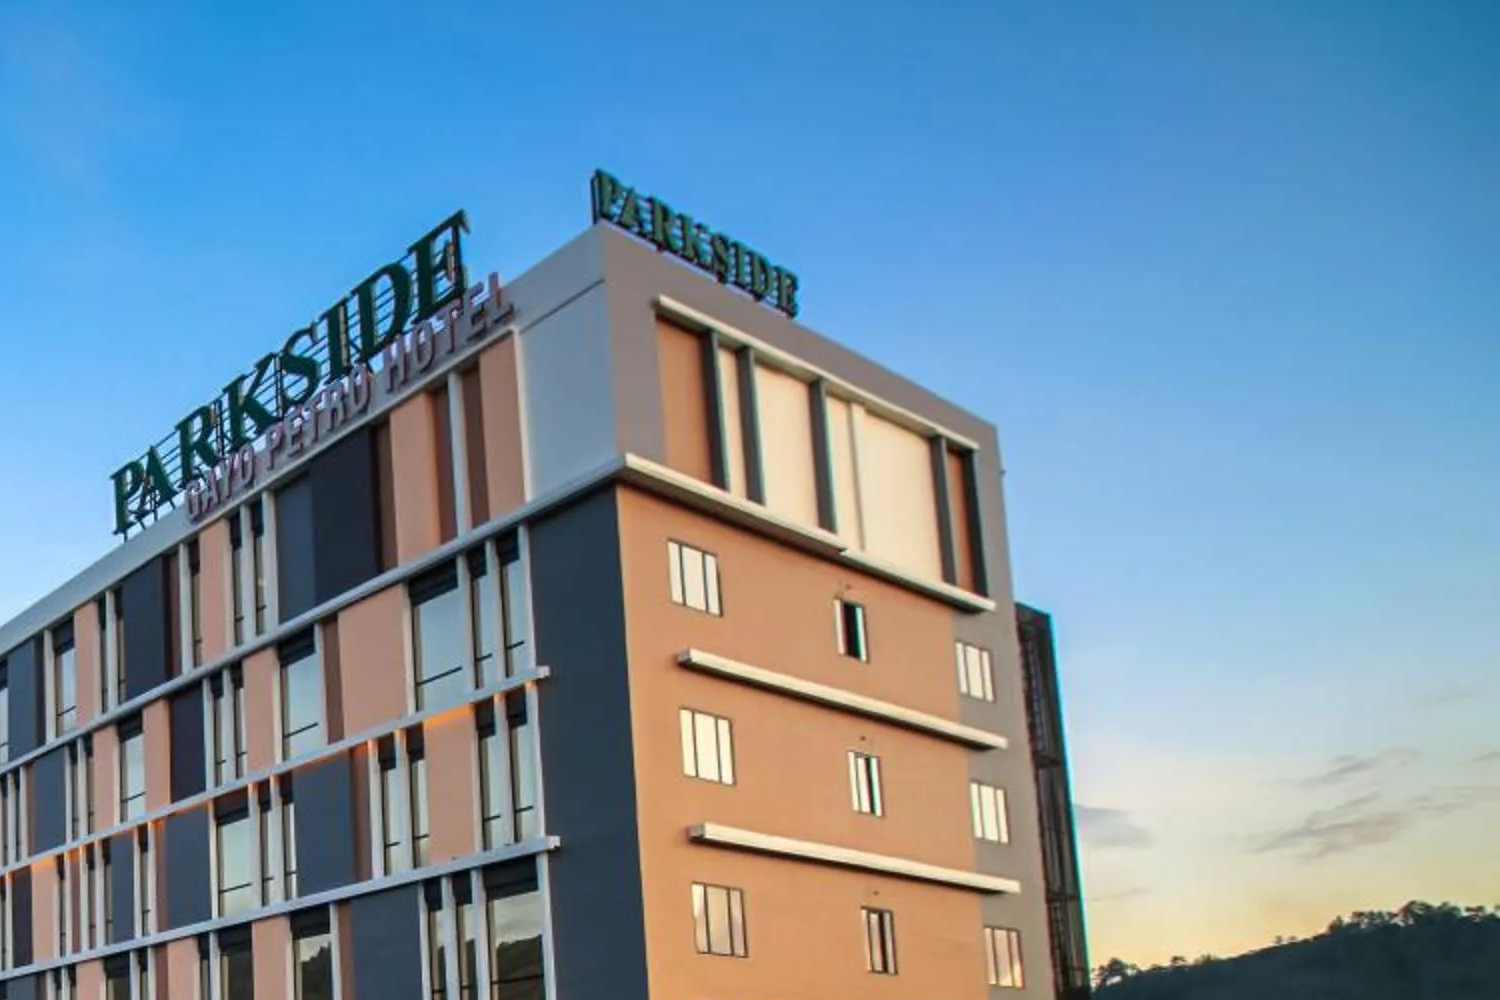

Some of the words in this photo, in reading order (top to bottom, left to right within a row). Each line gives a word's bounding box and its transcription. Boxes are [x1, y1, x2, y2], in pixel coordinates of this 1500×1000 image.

[593, 168, 799, 319] PARKSIDE
[110, 208, 471, 537] PARKSIDE
[185, 444, 256, 524] GAYO
[265, 362, 374, 471] PETRO
[383, 271, 517, 394] HOTEL
